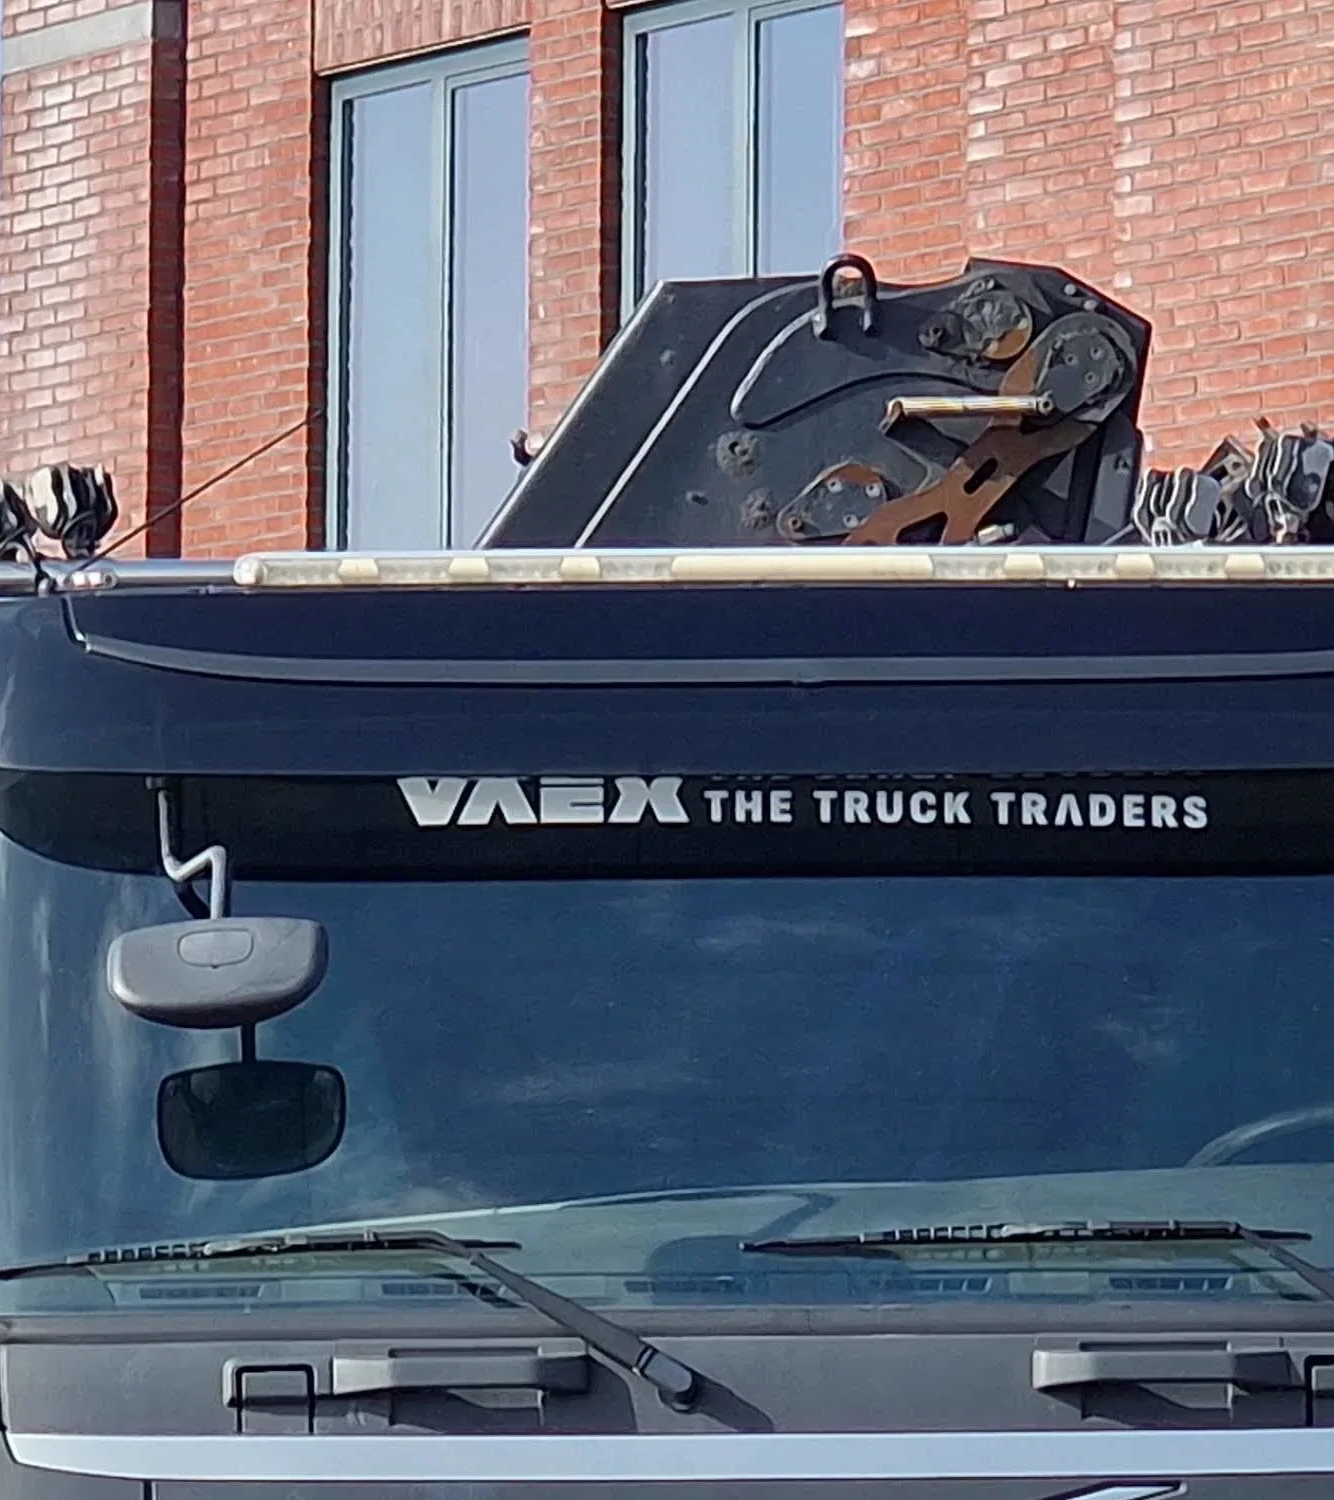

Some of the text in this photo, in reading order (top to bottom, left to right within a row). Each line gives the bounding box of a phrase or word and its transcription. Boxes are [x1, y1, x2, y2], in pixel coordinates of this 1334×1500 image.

[396, 776, 1208, 829] VAEX THE TRUCK TRADERS
